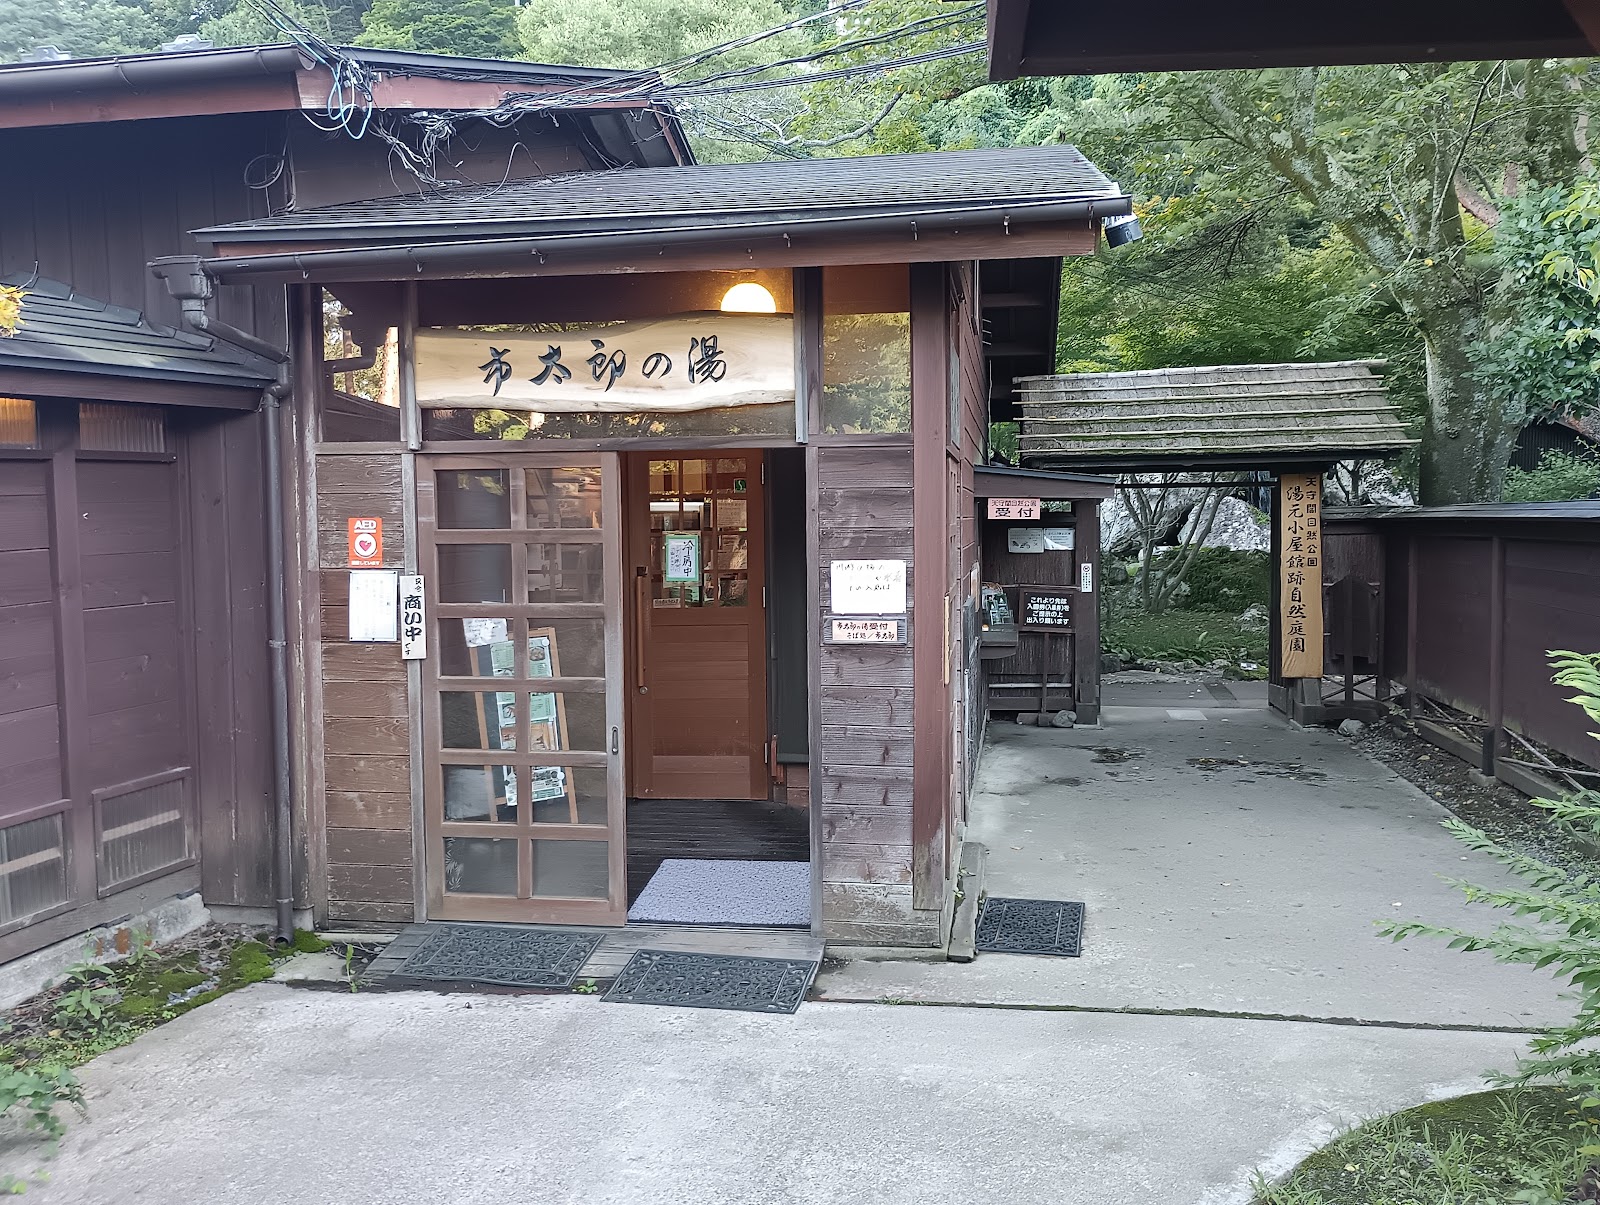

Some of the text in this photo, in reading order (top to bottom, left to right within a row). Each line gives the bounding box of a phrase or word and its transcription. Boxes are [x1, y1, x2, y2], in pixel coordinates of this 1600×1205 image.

[478, 334, 727, 397] 市太郎の湯
[995, 507, 1034, 518] 受付
[354, 520, 377, 529] AED
[1286, 485, 1307, 653] 湯元小屋館跡自然庭園
[1030, 597, 1068, 605] これより先は
[1026, 617, 1070, 625] 出入り願います
